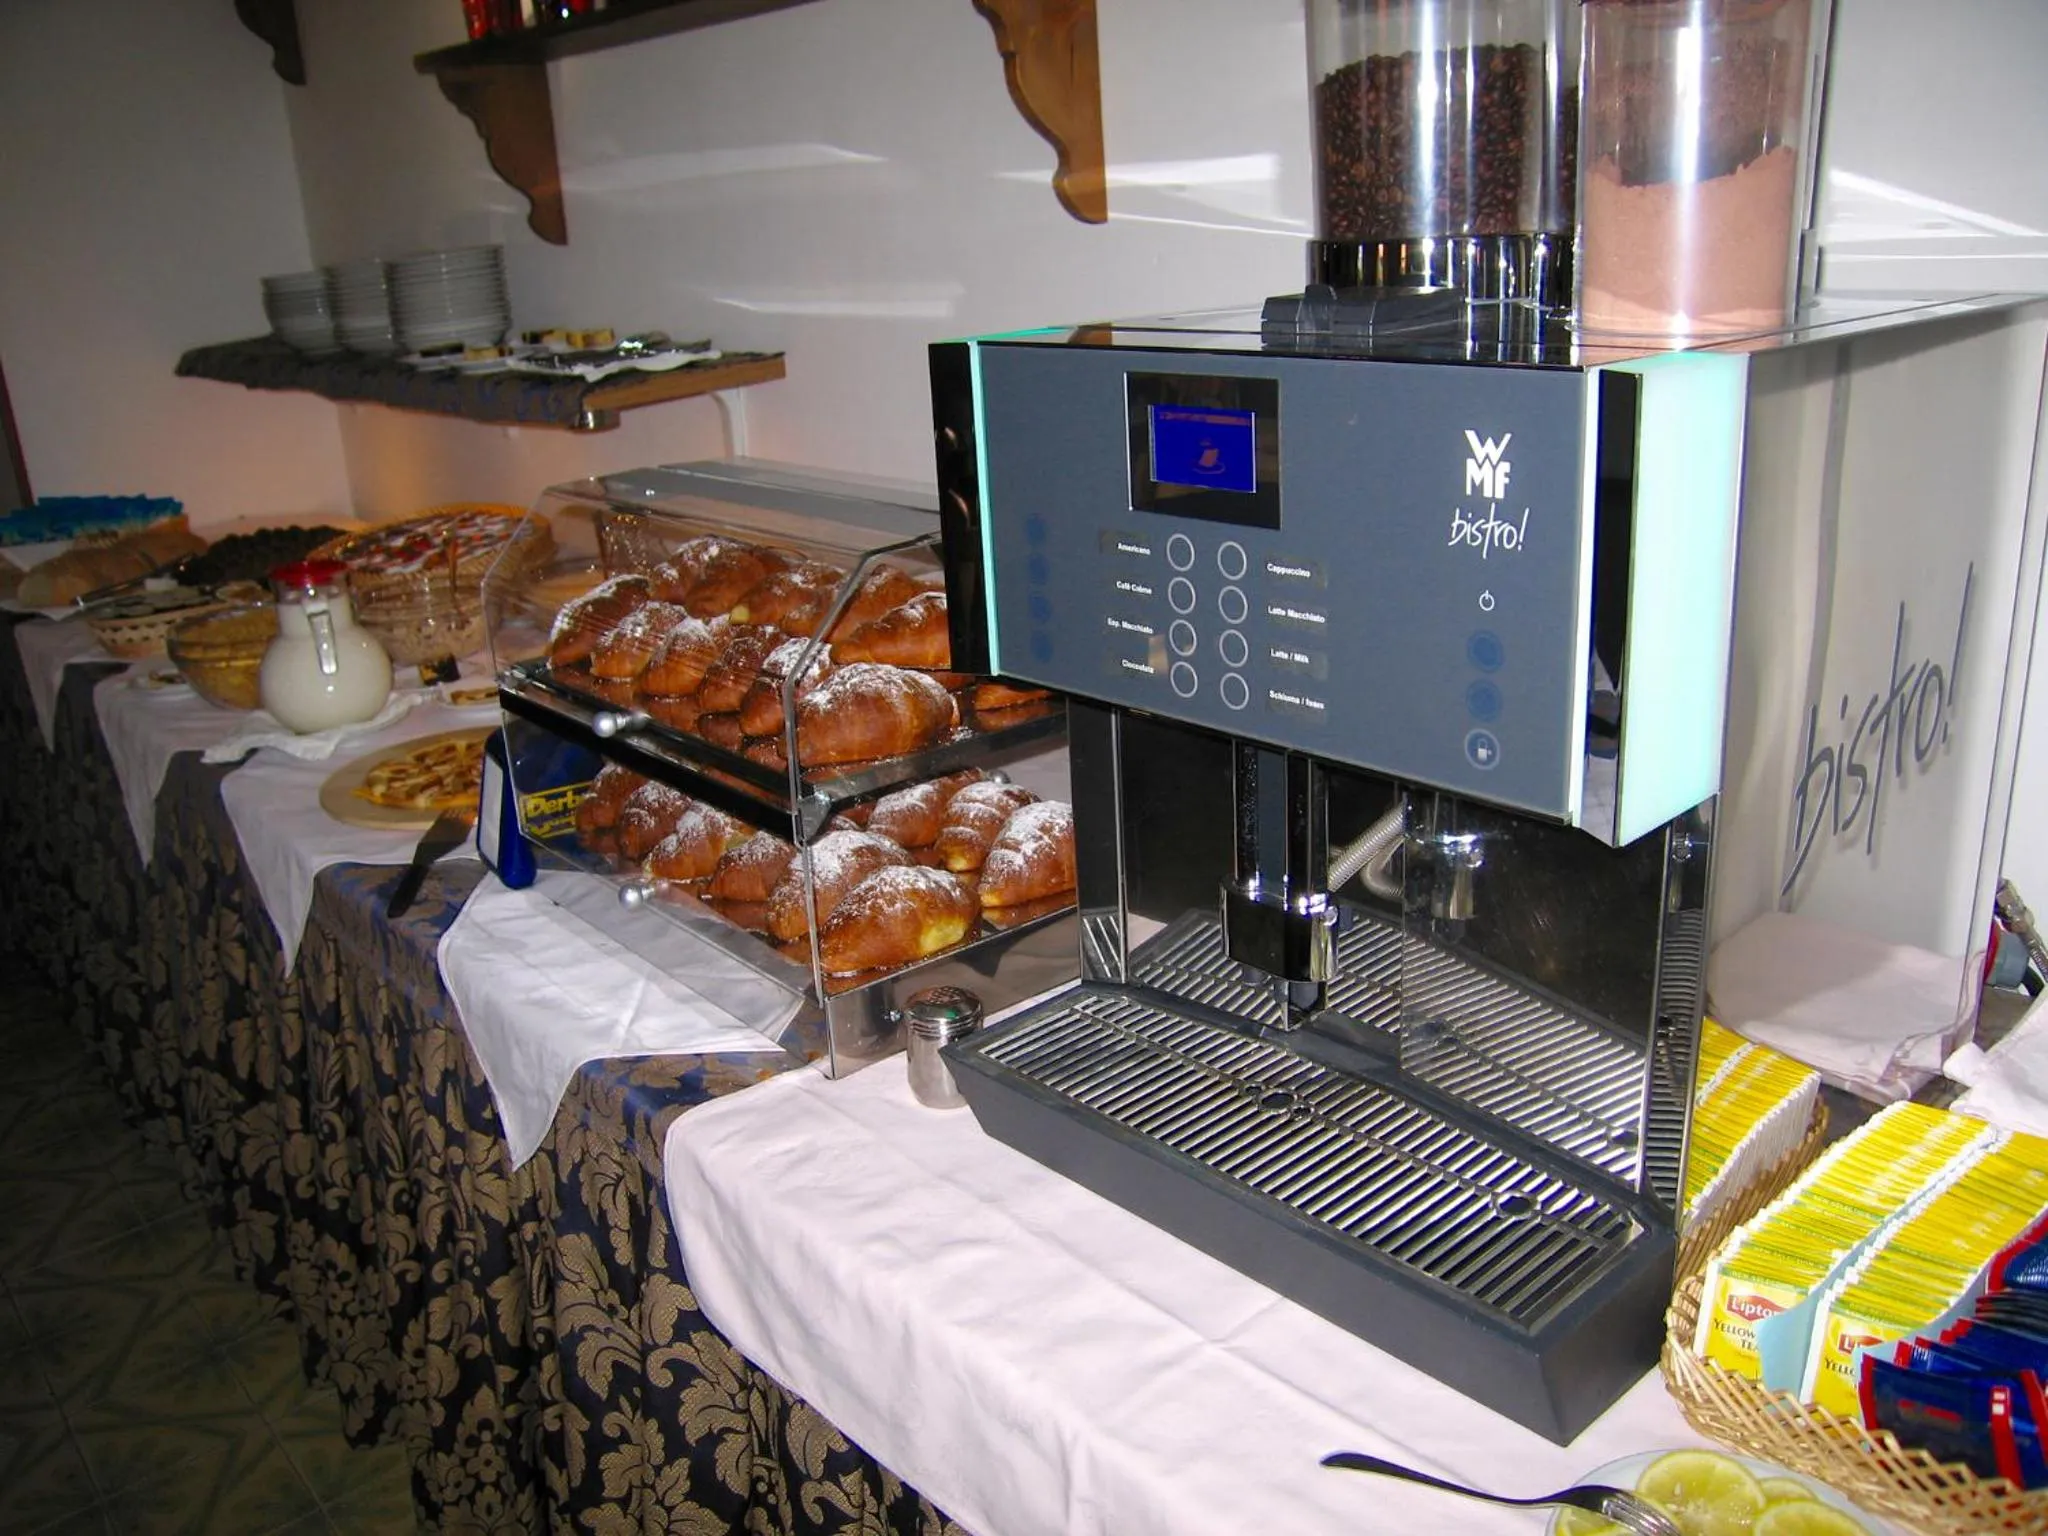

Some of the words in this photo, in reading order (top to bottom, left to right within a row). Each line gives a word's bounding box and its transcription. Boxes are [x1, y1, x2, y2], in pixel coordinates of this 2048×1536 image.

[1448, 502, 1530, 560] bistro!
[1117, 542, 1151, 556] Americano
[1266, 563, 1311, 578] Cappuccino
[1267, 605, 1286, 616] Latte
[1287, 607, 1326, 624] Macchiato
[1121, 620, 1153, 635] Macchiato
[1270, 647, 1289, 660] Latte
[1293, 652, 1310, 665] Milk
[1780, 560, 1974, 897] bistro!
[526, 790, 587, 818] Derb
